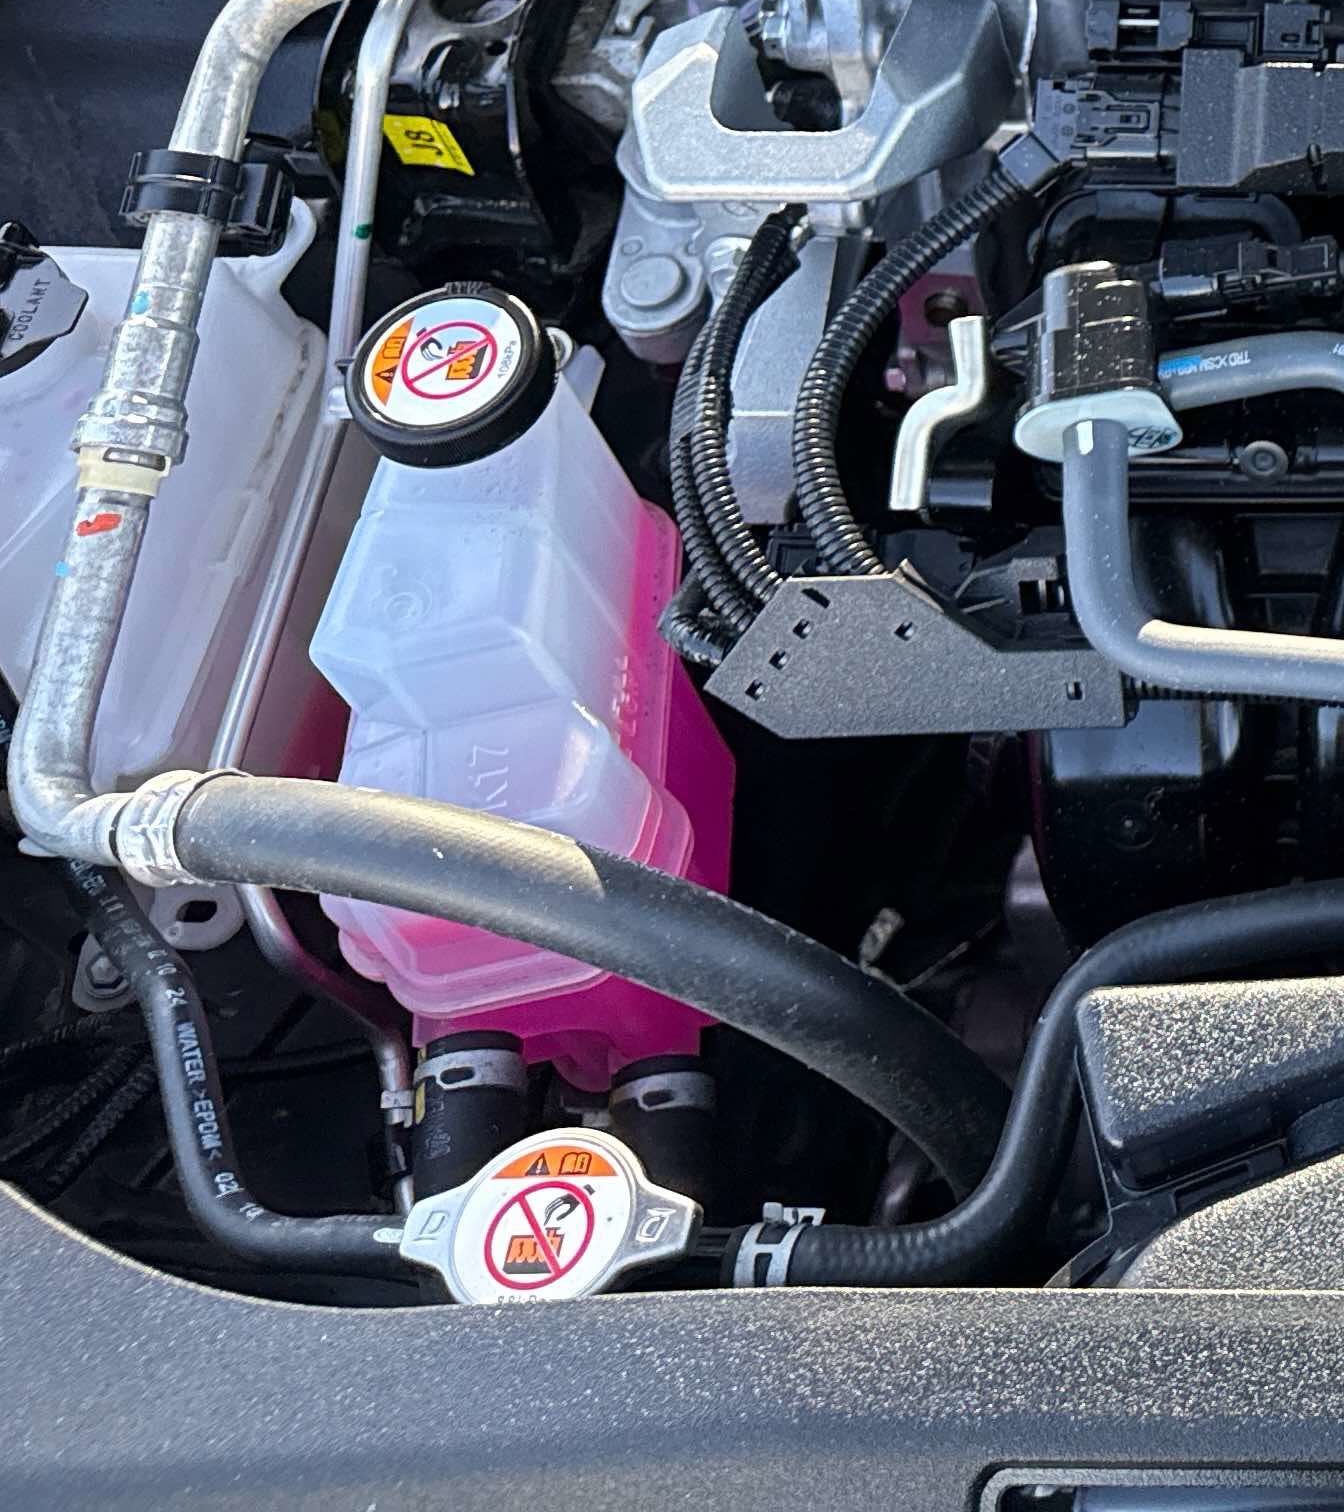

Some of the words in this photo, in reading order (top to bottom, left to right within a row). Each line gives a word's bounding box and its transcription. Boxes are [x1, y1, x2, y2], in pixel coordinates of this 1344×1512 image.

[413, 129, 444, 154] J8
[8, 277, 49, 342] COOLANT
[176, 1020, 208, 1086] WATER
